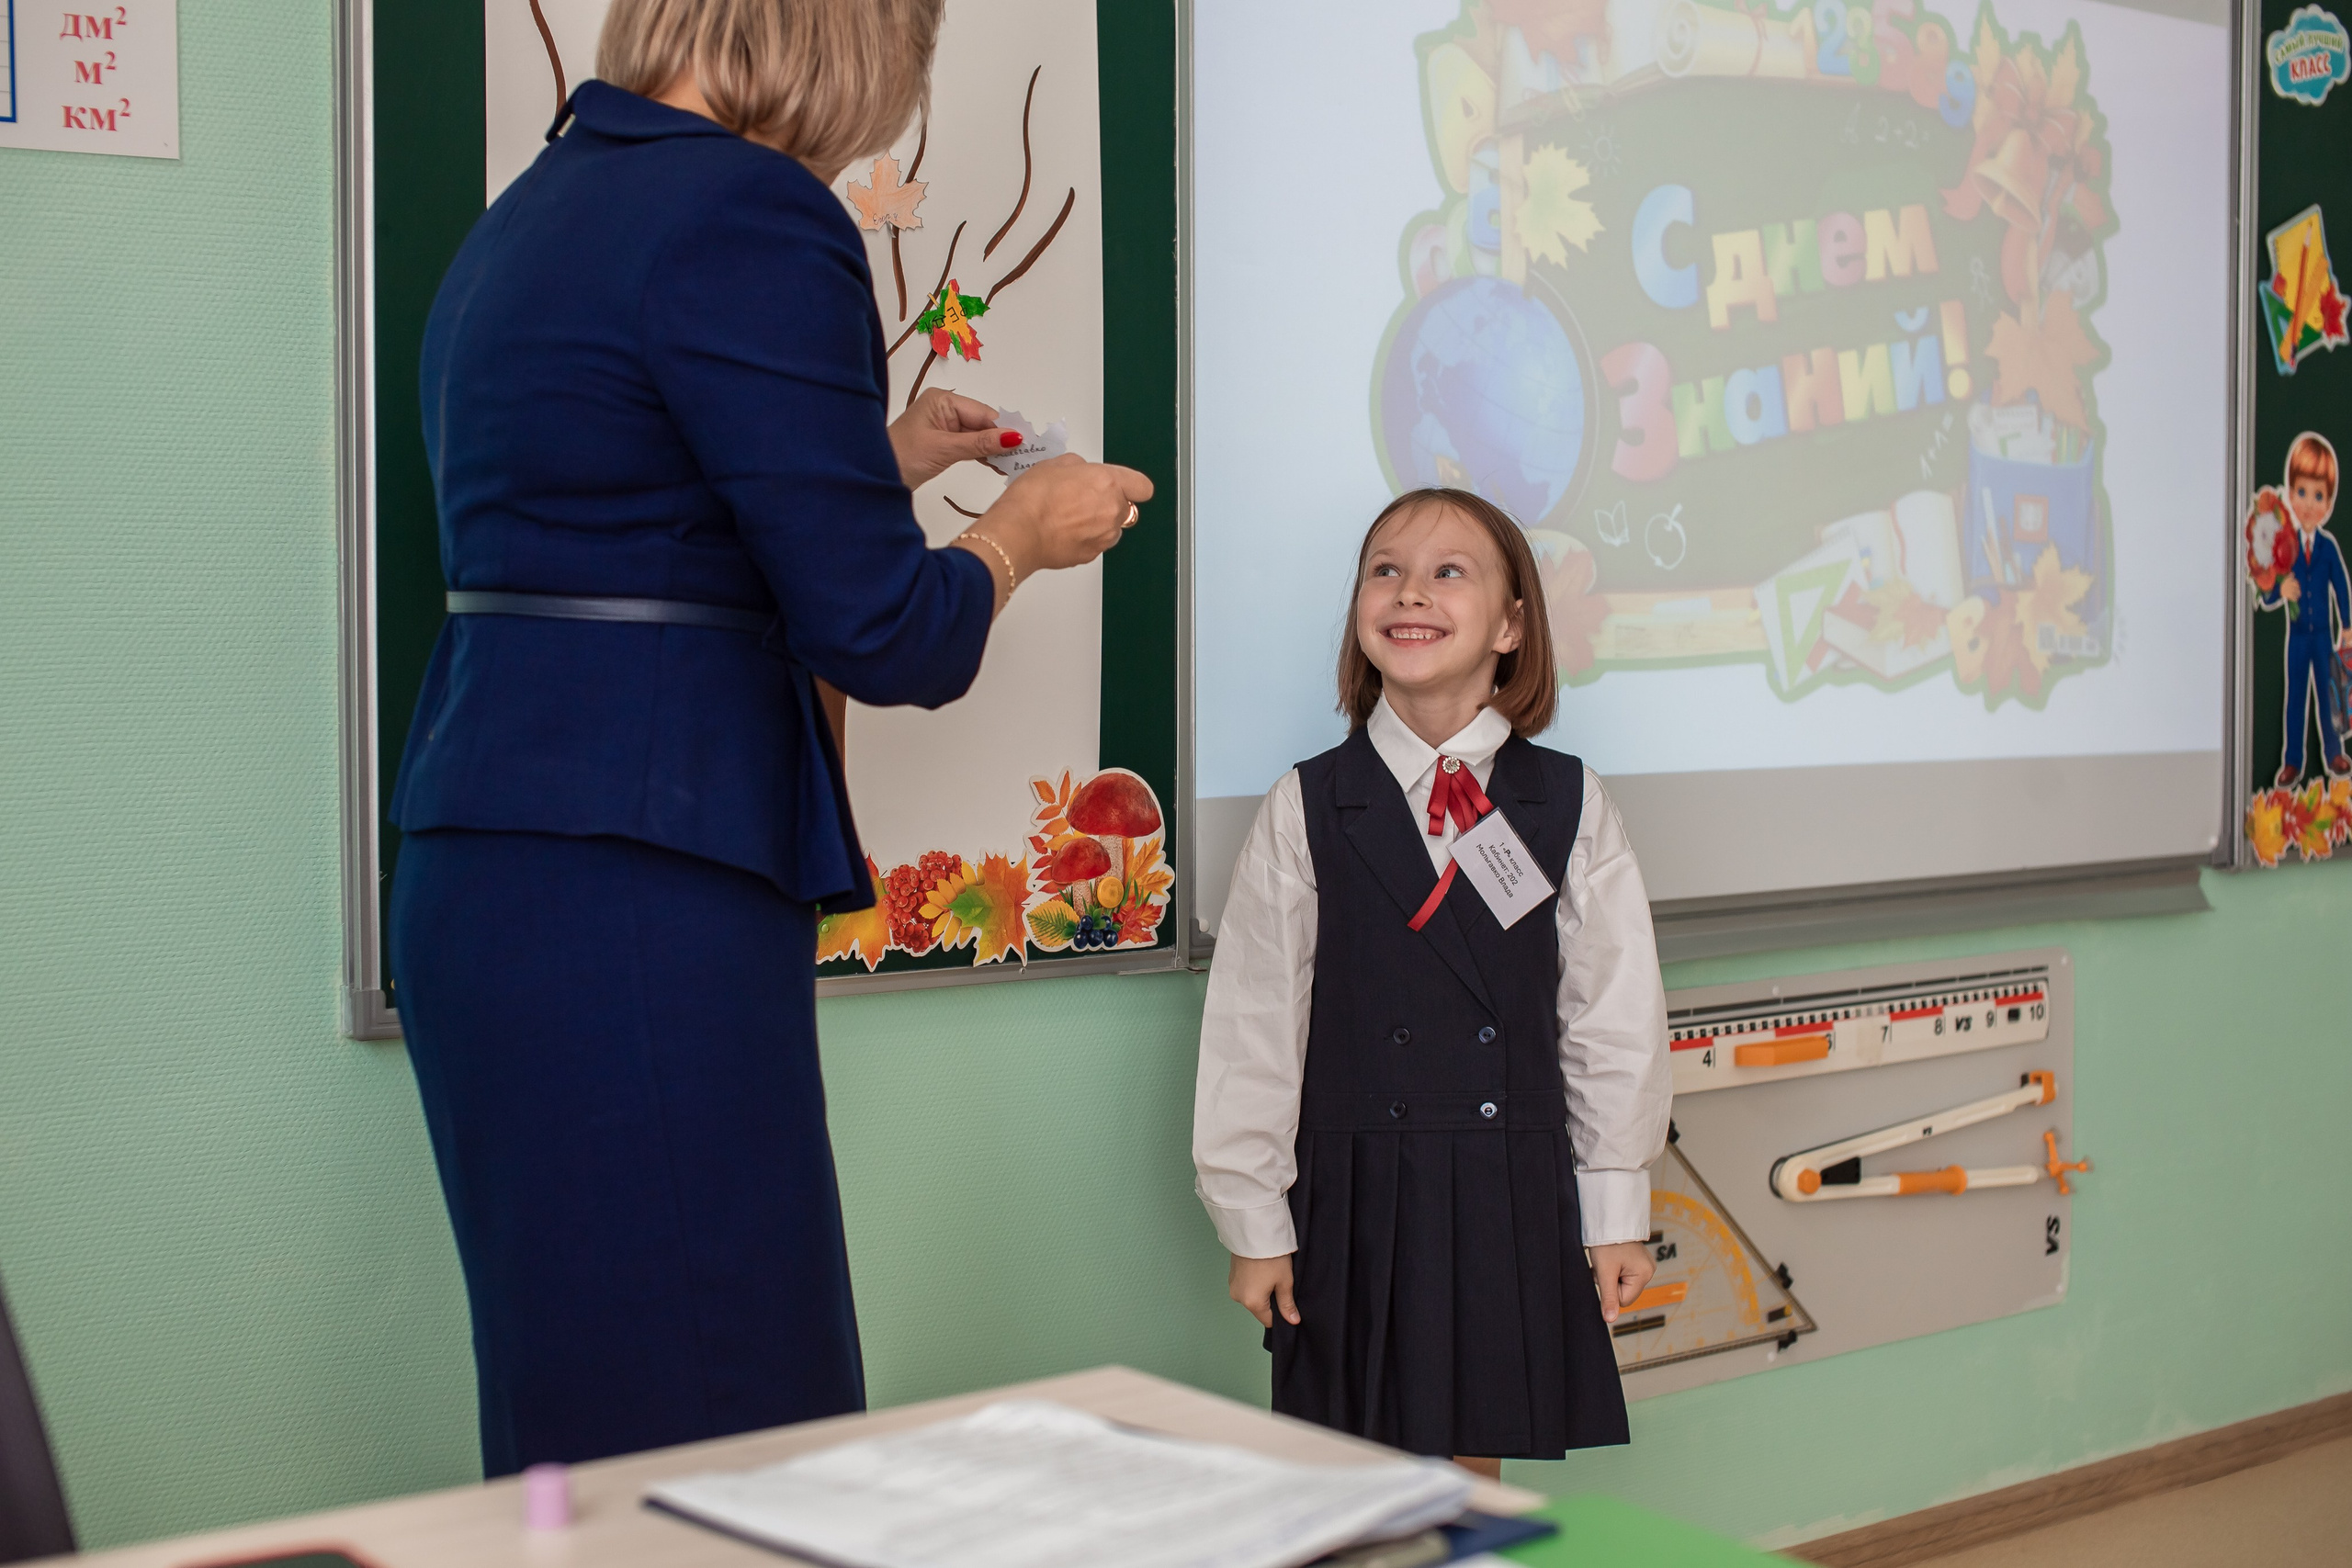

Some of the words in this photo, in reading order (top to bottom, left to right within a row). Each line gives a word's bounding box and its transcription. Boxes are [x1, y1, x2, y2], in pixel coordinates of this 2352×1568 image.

[2290, 52, 2331, 80] КЛАСС
[1632, 184, 1700, 309] С
[1600, 299, 1973, 482] Знаний!
[1476, 843, 1500, 878] Мольгавко
[1498, 876, 1514, 898] Влада
[1507, 873, 1519, 886] 202
[1510, 858, 1524, 877] класс
[1702, 1050, 1713, 1067] 4
[1881, 1025, 1889, 1043] 7
[1934, 1017, 1943, 1035] 8
[1986, 1010, 1995, 1029] 9
[2030, 1003, 2044, 1021] 10
